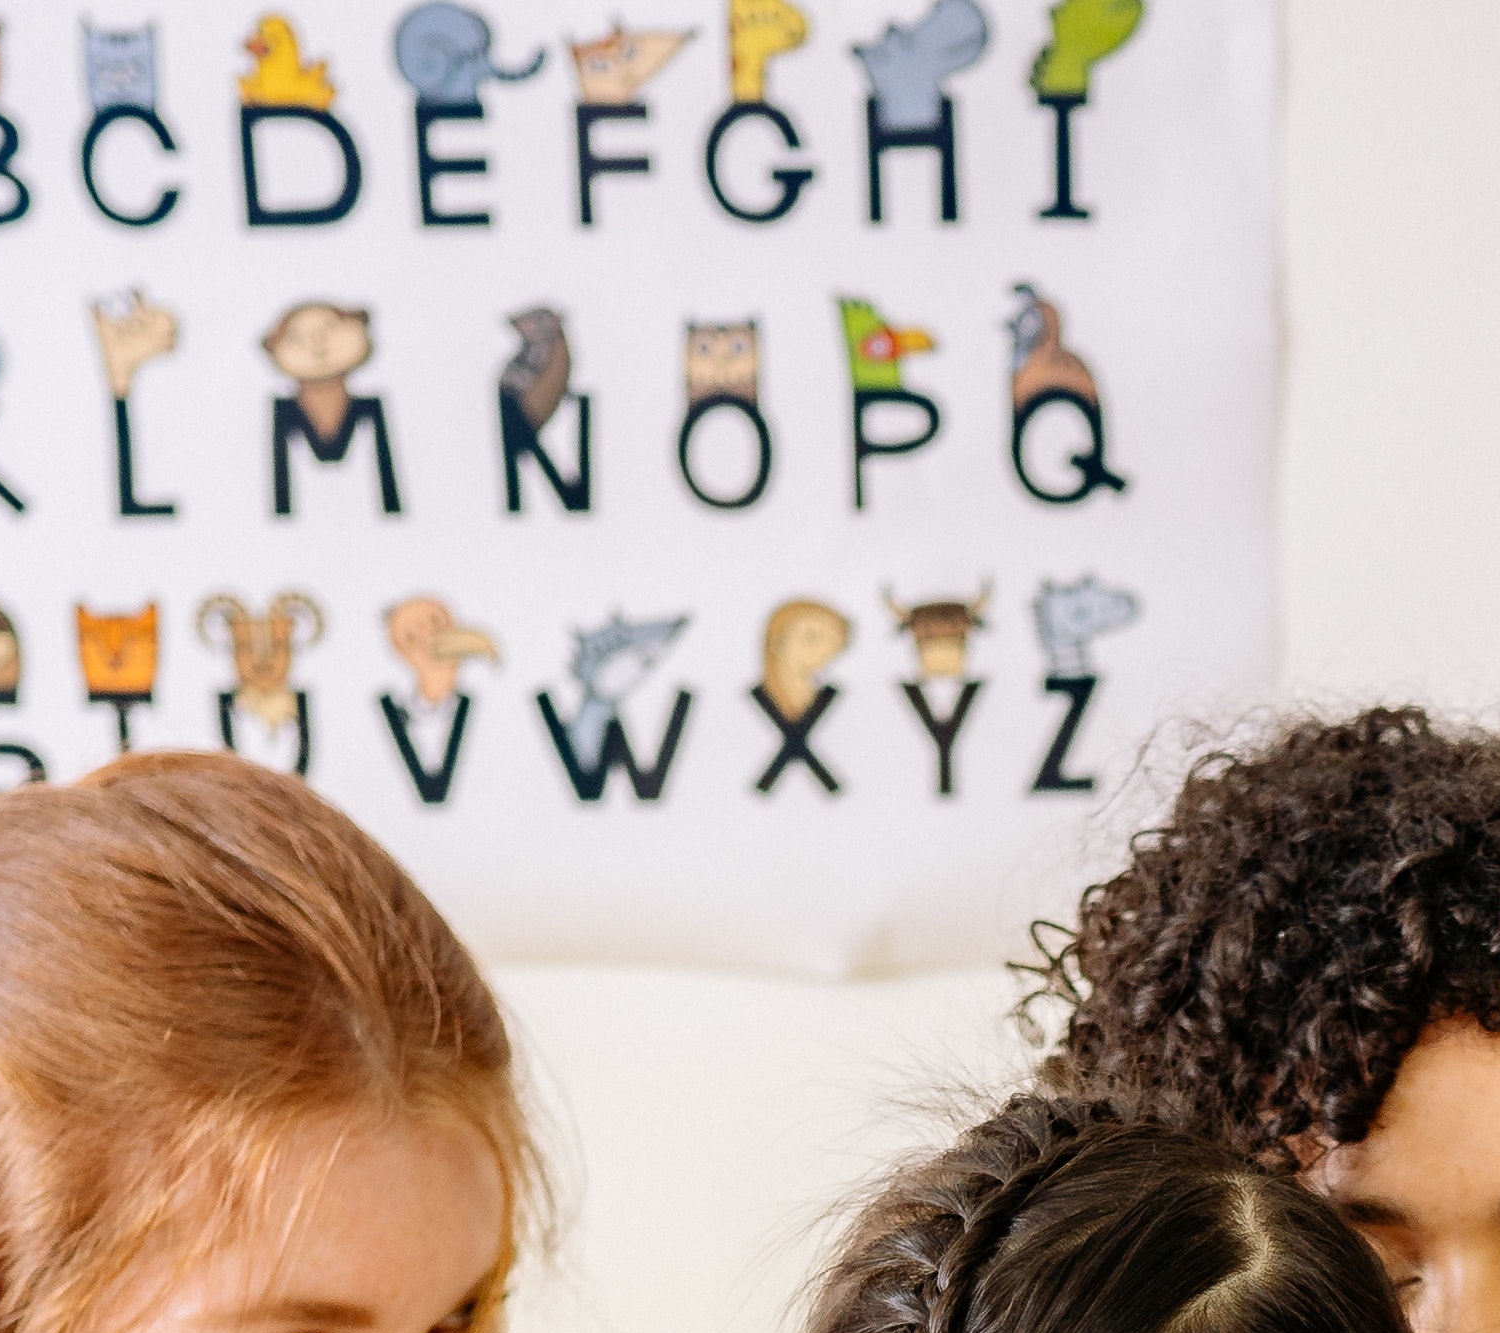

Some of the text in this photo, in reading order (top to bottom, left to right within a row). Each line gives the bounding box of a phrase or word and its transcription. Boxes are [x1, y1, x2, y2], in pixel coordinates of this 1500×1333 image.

[79, 101, 180, 229] C
[237, 101, 364, 229] D
[412, 95, 492, 229] E
[573, 99, 652, 228] F
[703, 97, 816, 226] G
[864, 93, 960, 225] H
[1035, 87, 1094, 222] I
[113, 395, 176, 518] L
[270, 393, 403, 517] M
[496, 387, 593, 515] N
[675, 388, 776, 512] O
[849, 384, 943, 511] P
[1009, 383, 1129, 507] Q
[378, 692, 472, 806] V
[534, 688, 694, 803] W
[750, 682, 843, 796] X
[901, 679, 983, 796] Y
[1030, 672, 1099, 794] Z
